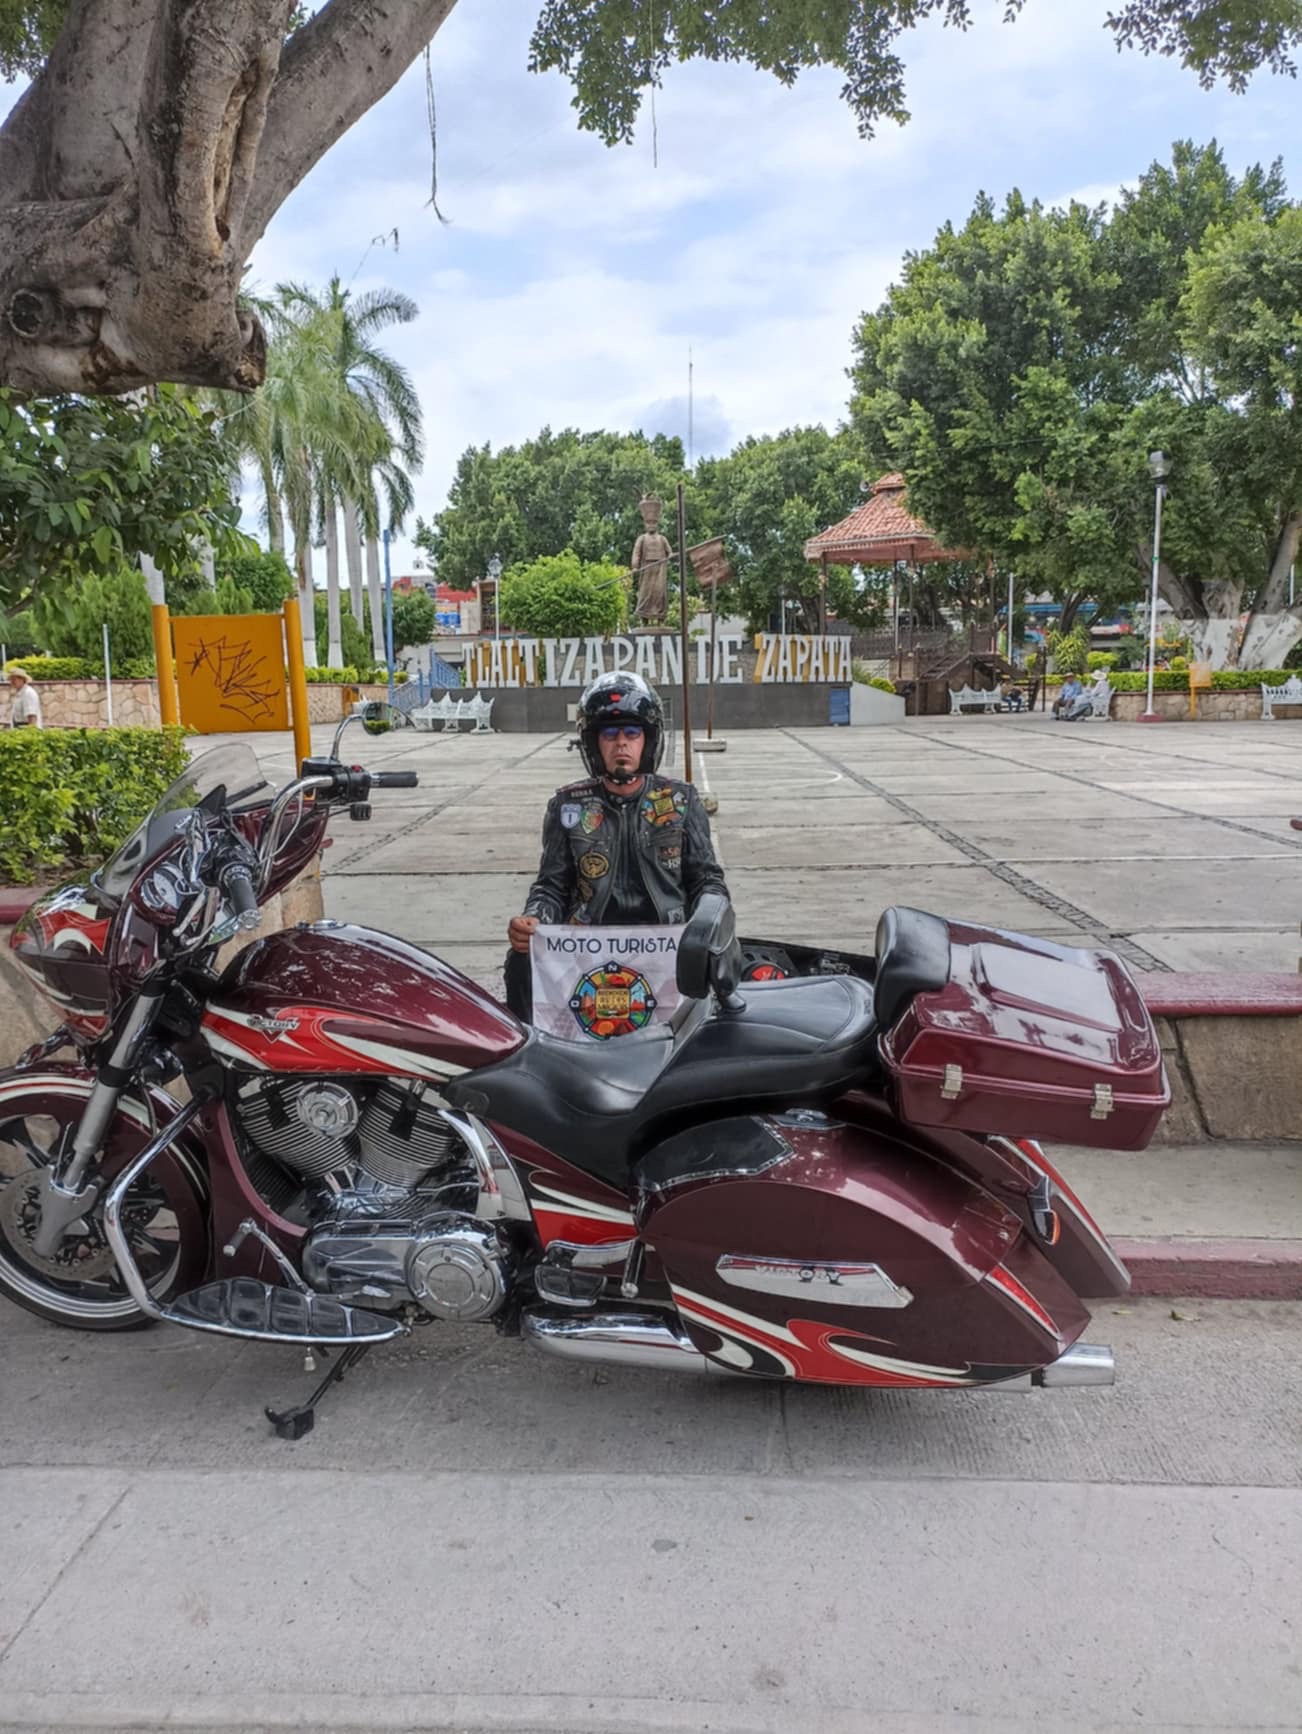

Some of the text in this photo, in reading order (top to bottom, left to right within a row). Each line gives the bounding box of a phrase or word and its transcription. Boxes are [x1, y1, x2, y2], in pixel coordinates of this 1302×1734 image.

[462, 633, 853, 688] TLALTIZAPAN DE ZAPATA
[546, 937, 677, 954] MOTO TURISTA
